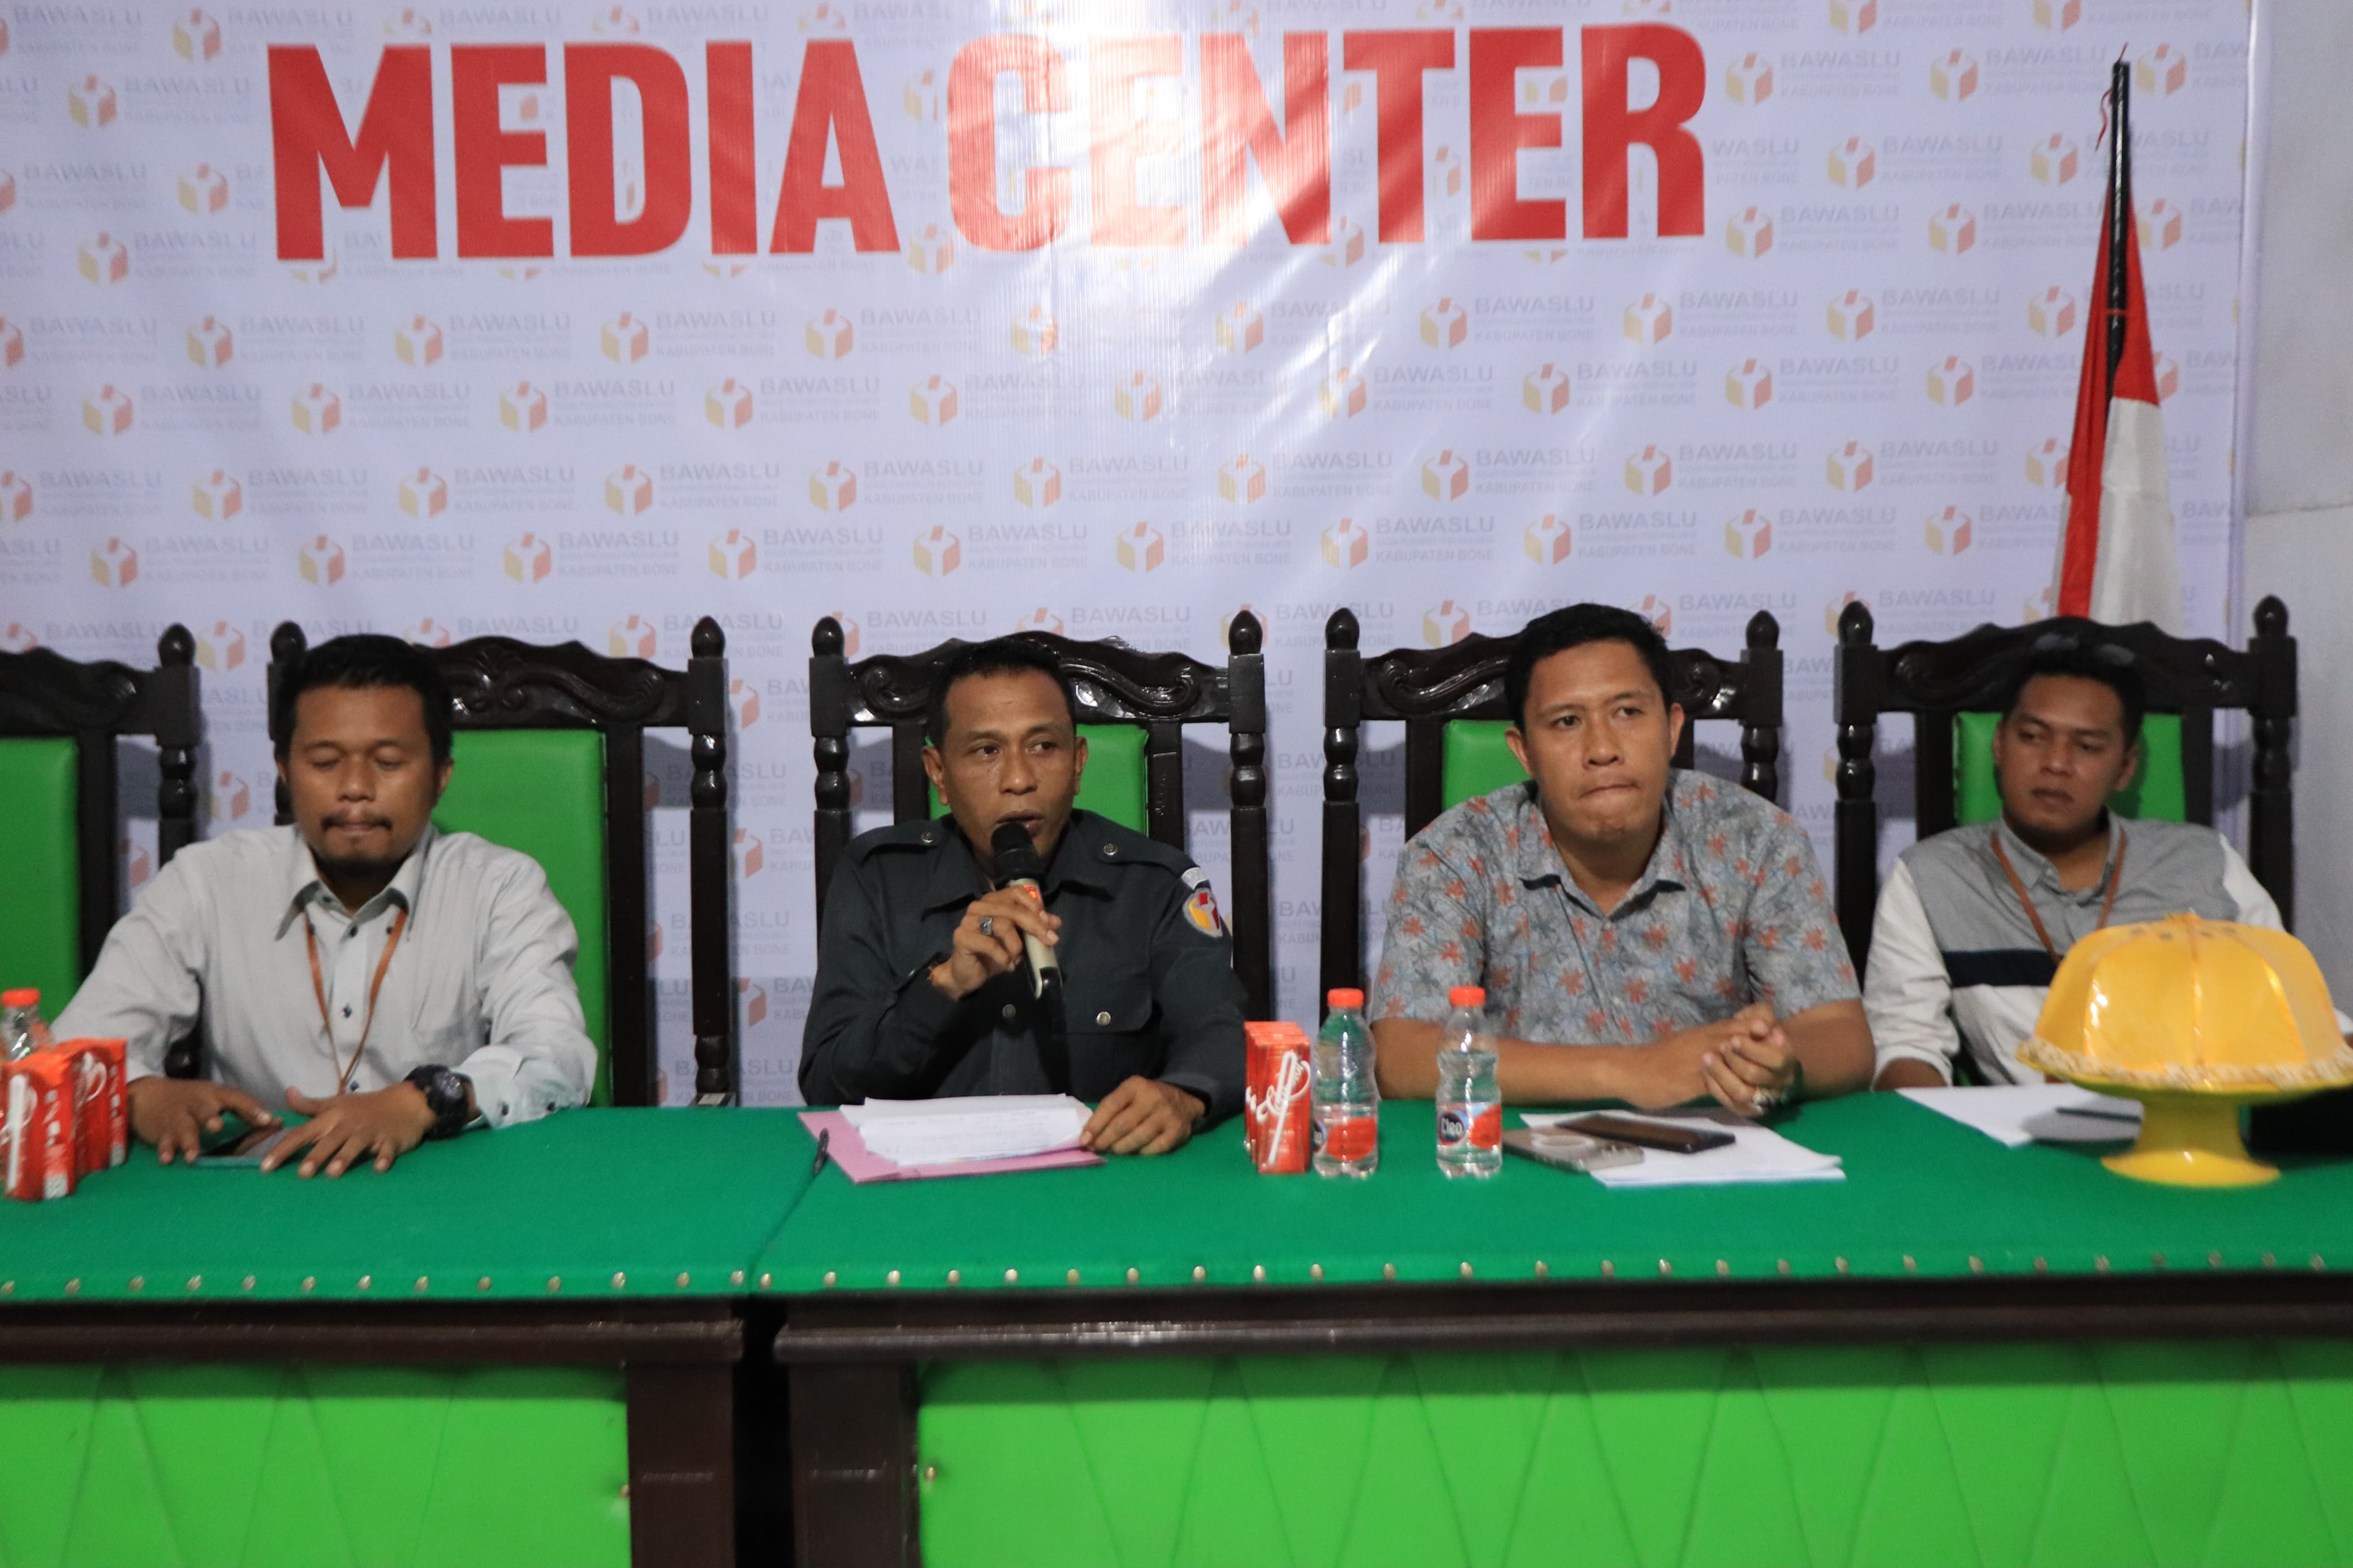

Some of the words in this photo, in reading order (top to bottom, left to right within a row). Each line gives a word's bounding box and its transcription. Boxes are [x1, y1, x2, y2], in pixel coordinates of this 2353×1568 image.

[438, 5, 562, 25] BAWASLU
[647, 2, 770, 21] BAWASLU
[1781, 50, 1902, 70] BAWASLU
[267, 39, 901, 261] MEDIA
[947, 23, 1706, 252] CENTER
[1712, 137, 1799, 157] WASLU
[1882, 134, 2002, 154] BAWASLU
[1780, 204, 1899, 224] BAWASLU
[1475, 295, 1594, 314] BAWASLU
[1679, 290, 1798, 310] BAWASLU
[1881, 286, 2001, 306] BAWASLU
[449, 313, 571, 332] BAWASLU
[655, 309, 777, 329] BAWASLU
[860, 306, 981, 326] BAWASLU
[1557, 328, 1593, 340] BONE
[1761, 323, 1797, 336] BONE
[739, 343, 776, 356] BONE
[944, 340, 980, 352] BONE
[1578, 360, 1697, 379] BAWASLU
[1779, 356, 1899, 375] BAWASLU
[1981, 352, 2082, 372] BAWASL
[1374, 364, 1493, 384] BAWASLU
[554, 379, 675, 399] BAWASLU
[759, 375, 880, 395] BAWASLU
[1456, 398, 1492, 411] BONE
[1660, 393, 1696, 405] BONE
[1861, 389, 1898, 401] BONE
[843, 409, 880, 421] BONE
[1476, 446, 1595, 466] BAWASLU
[1678, 442, 1798, 461] BAWASLU
[1880, 438, 1999, 458] BAWASLU
[660, 461, 780, 481] BAWASLU
[863, 458, 984, 478] BAWASLU
[1068, 454, 1188, 474] BAWASLU
[454, 465, 575, 485] BAWASLU
[1760, 475, 1796, 487] BONE
[1151, 487, 1187, 500] BONE
[1356, 484, 1391, 496] BONE
[1558, 480, 1594, 492] BONE
[743, 495, 780, 507] BONE
[947, 491, 983, 504] BONE
[1375, 515, 1494, 535] BAWASLU
[1578, 510, 1697, 530] BAWASLU
[1779, 506, 1898, 526] BAWASLU
[558, 530, 679, 549] BAWASLU
[762, 526, 883, 546] BAWASLU
[968, 522, 1088, 542] BAWASLU
[1458, 548, 1493, 560] BONE
[1660, 543, 1696, 556] BONE
[1860, 539, 1897, 552] BONE
[846, 559, 882, 572] BONE
[1051, 556, 1087, 568] BONE
[1254, 552, 1290, 564] BONE
[1679, 591, 1798, 611] BAWASLU
[1879, 588, 1998, 607] BAWASLU
[867, 607, 988, 627] BAWASLU
[1071, 604, 1191, 624] BAWASLU
[458, 615, 579, 634] BAWASLU
[1154, 637, 1190, 649] BONE
[1357, 633, 1393, 645] BONE
[747, 645, 783, 657] BONE
[1442, 1117, 1463, 1135] Cleo
